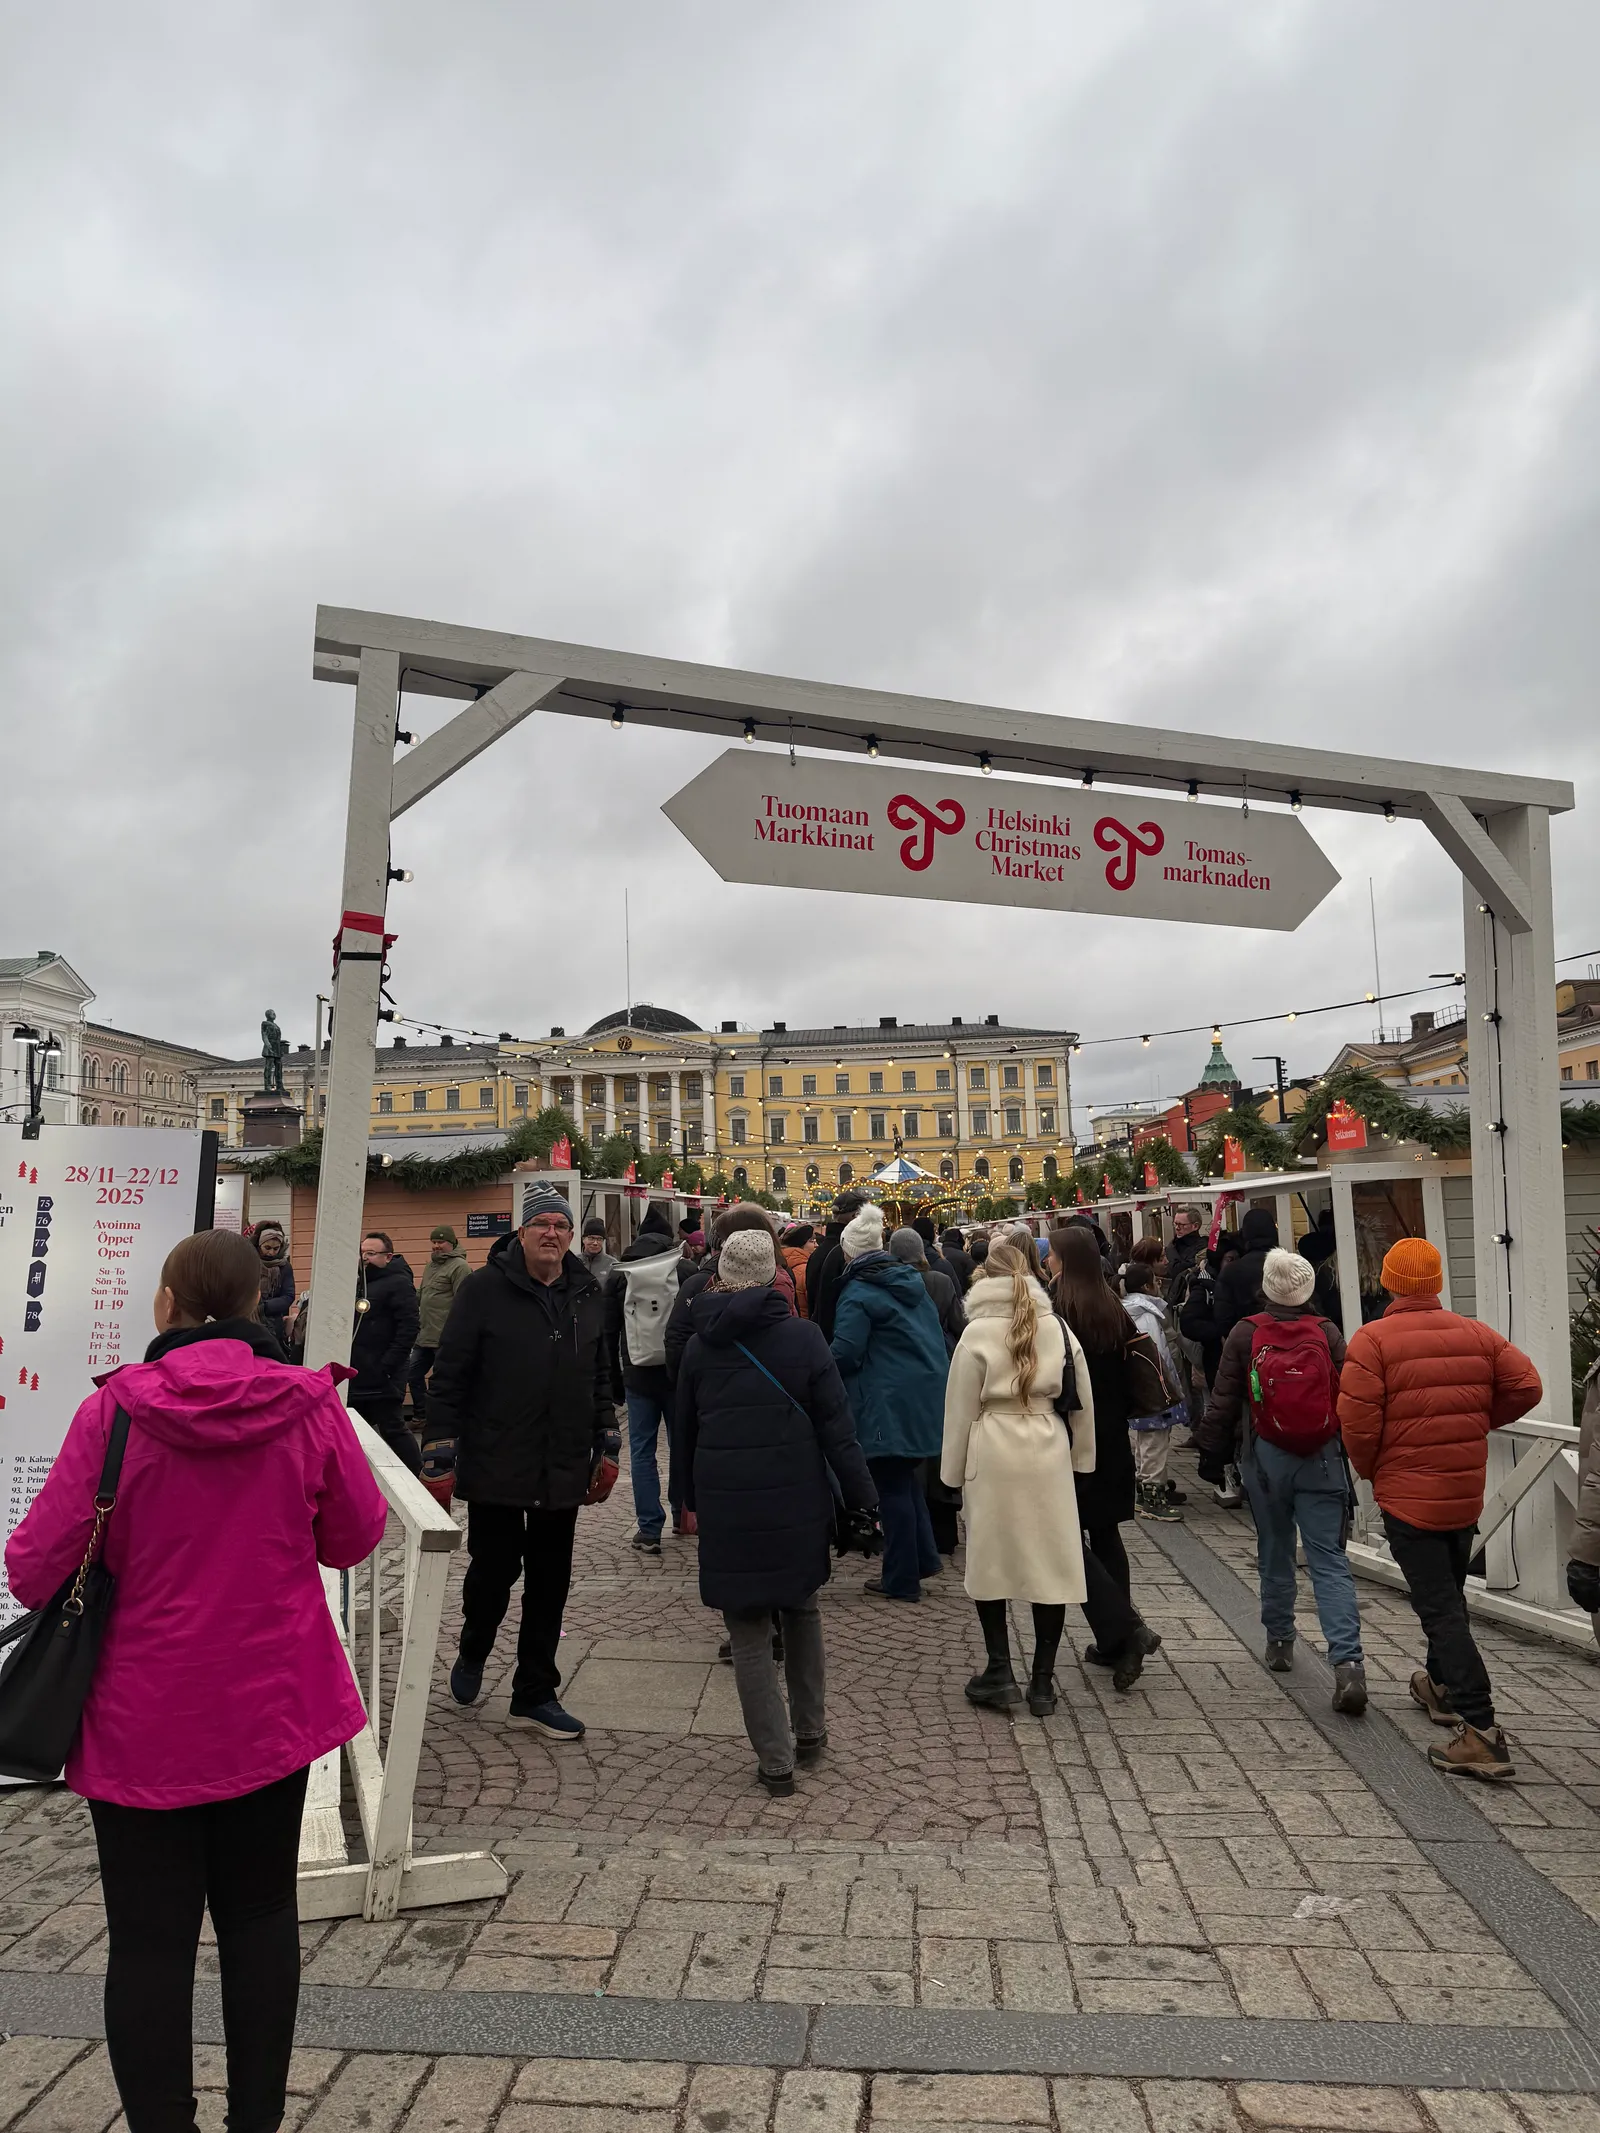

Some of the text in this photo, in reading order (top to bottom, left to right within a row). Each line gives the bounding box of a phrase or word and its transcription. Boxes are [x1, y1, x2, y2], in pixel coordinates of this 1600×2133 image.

[761, 795, 869, 826] Tuomaan
[988, 808, 1071, 836] Helsinki
[754, 819, 875, 851] Markkinat
[975, 830, 1081, 860] Christmas
[1184, 841, 1252, 866] Tomas-
[991, 855, 1065, 882] Market
[1163, 865, 1271, 891] marknaden
[96, 1188, 144, 1205] 2025
[37, 1217, 48, 1225] 76
[93, 1220, 141, 1230] Avoinna
[35, 1239, 46, 1247] 77
[97, 1232, 133, 1246] Öppet
[97, 1247, 130, 1260] Open
[27, 1311, 38, 1319] 78
